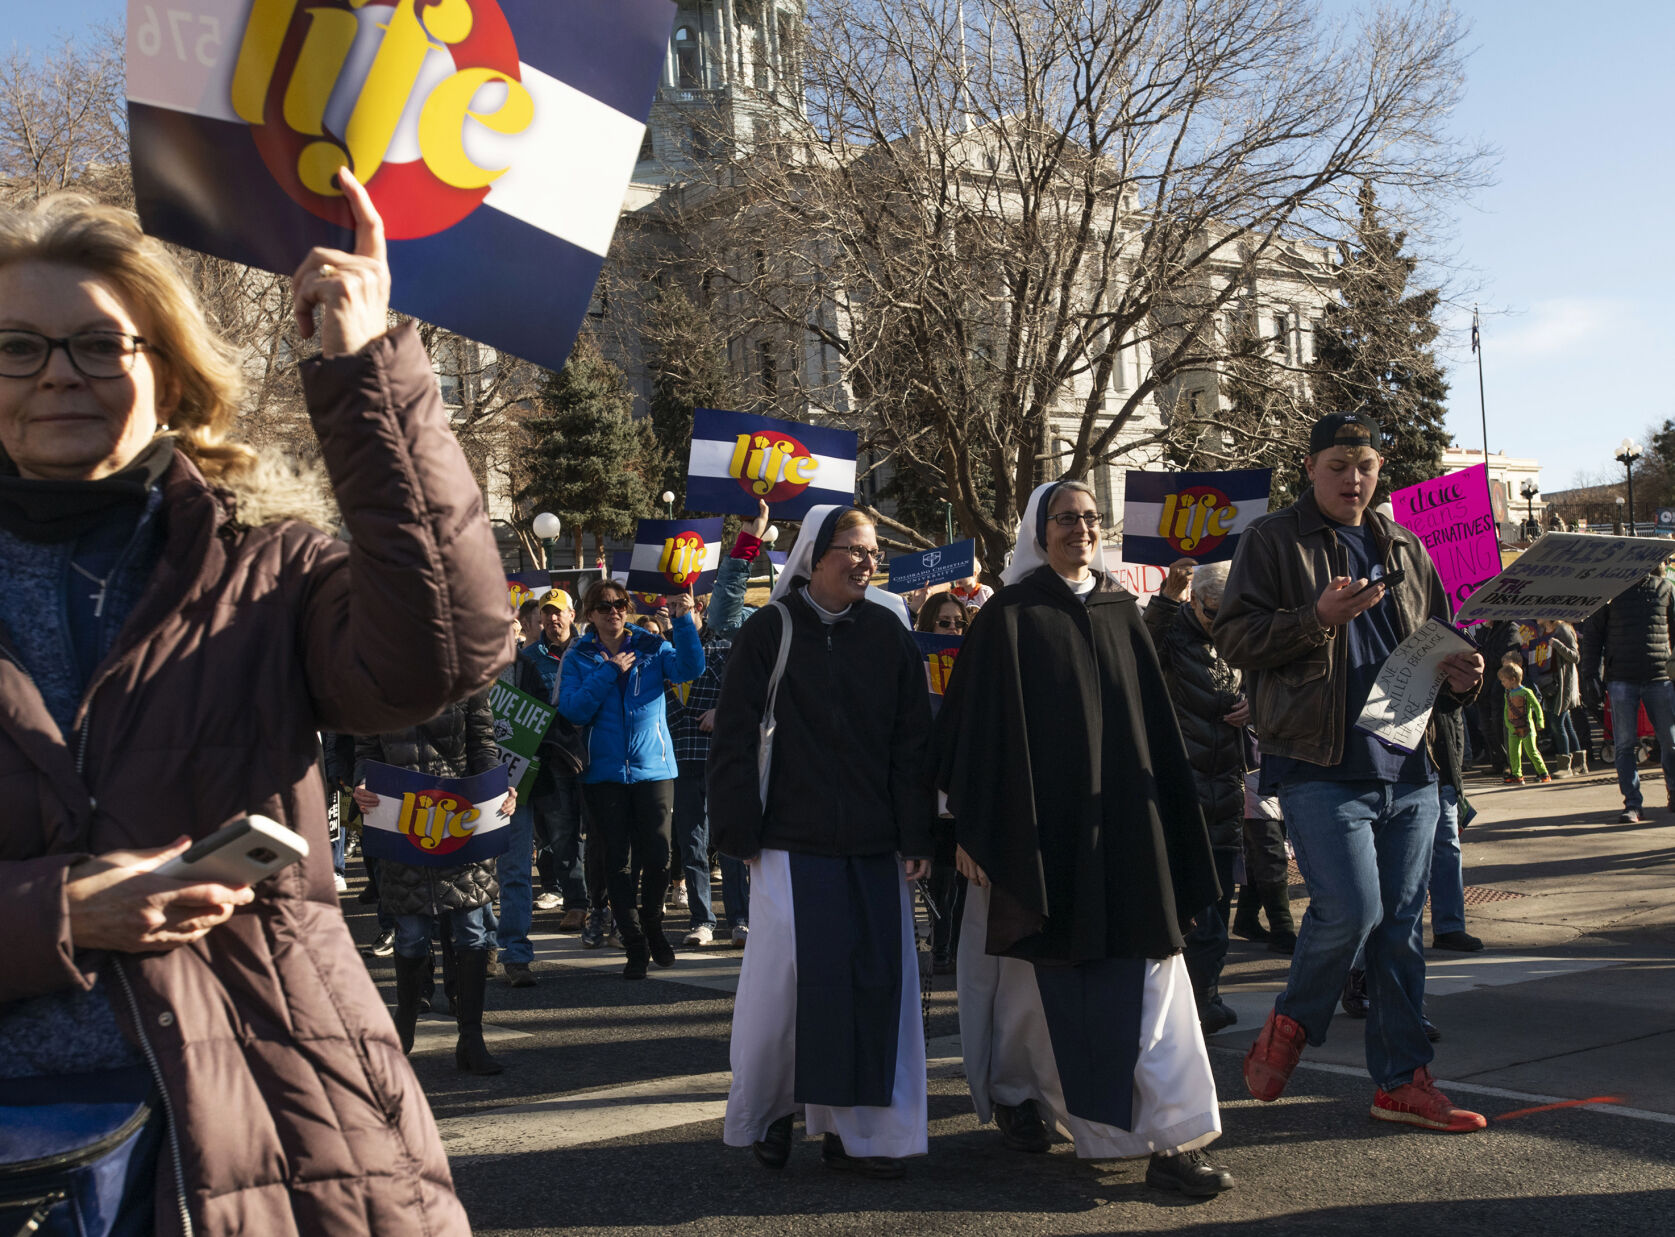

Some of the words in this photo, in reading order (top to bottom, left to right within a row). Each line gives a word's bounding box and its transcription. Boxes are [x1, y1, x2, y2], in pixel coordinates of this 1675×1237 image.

[231, 0, 535, 196] life
[729, 433, 819, 496] life
[1158, 494, 1238, 551] life
[658, 537, 707, 584] life
[893, 569, 931, 582] COLORADO
[932, 560, 969, 573] CHRISTIAN
[906, 569, 954, 584] UNIVERSITY
[1494, 578, 1534, 594] THE
[1395, 622, 1438, 658] SHOULD
[1408, 634, 1445, 667] BECAUSE
[489, 684, 520, 717] OVE
[514, 699, 552, 735] LIFE
[397, 791, 481, 850] life
